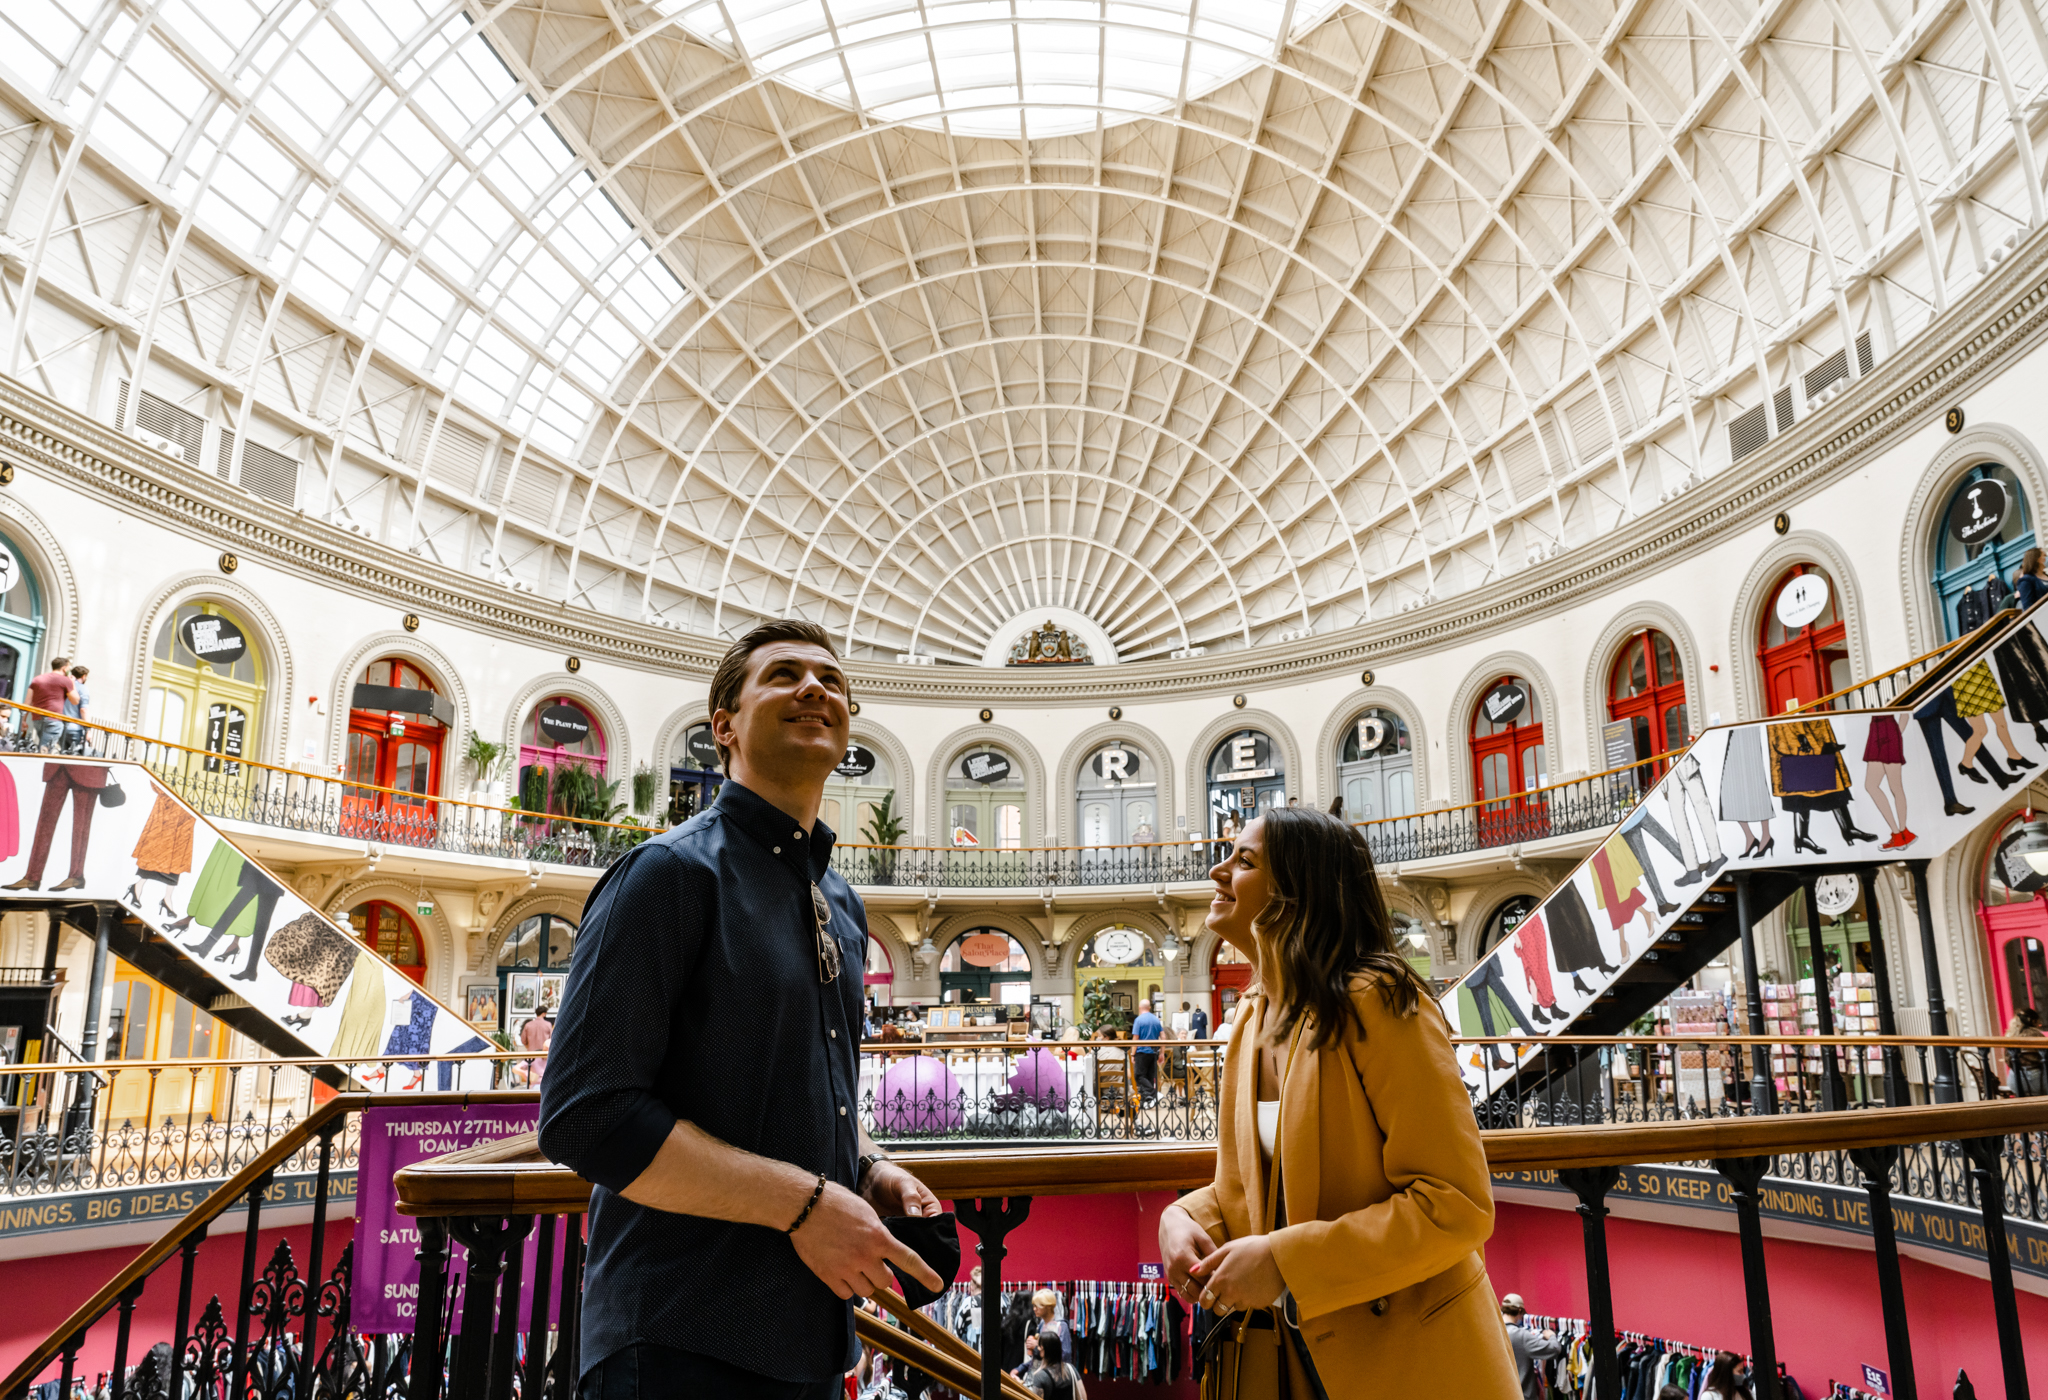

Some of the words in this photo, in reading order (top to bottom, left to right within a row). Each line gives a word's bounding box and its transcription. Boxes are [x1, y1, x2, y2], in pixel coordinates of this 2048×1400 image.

[1948, 412, 1958, 428] 3
[1776, 516, 1784, 529] 4
[224, 554, 236, 569] 13
[406, 616, 418, 628] 12
[570, 658, 578, 669] 11
[1364, 674, 1371, 682] 5
[1236, 696, 1242, 705] 6
[983, 711, 990, 719] 8
[1112, 709, 1118, 717] 7
[543, 717, 554, 725] THE
[555, 719, 572, 729] PLANT
[572, 722, 588, 732] POINT
[1358, 717, 1384, 751] D
[704, 743, 717, 751] PLAN
[1232, 737, 1256, 769] E
[1102, 749, 1129, 779] R
[1504, 916, 1516, 924] MR
[386, 1120, 462, 1137] THURSDAY
[464, 1120, 502, 1135] 27TH
[506, 1119, 540, 1134] MAY
[419, 1138, 458, 1153] 10AM
[0, 1203, 76, 1230] NINGS,
[86, 1198, 122, 1220] BIG
[130, 1191, 198, 1216] IDEAS,
[294, 1177, 358, 1199] TUNE
[1638, 1174, 1660, 1195] SO
[1666, 1176, 1711, 1200] KEEP
[1757, 1187, 1828, 1218] RINDING.
[1833, 1198, 1870, 1226] LIVE
[1891, 1207, 1914, 1234] OW
[1920, 1213, 1954, 1243] YOU
[1959, 1220, 2023, 1262] DRM,
[1143, 1264, 1158, 1274] £15
[1866, 1367, 1882, 1386] £15
